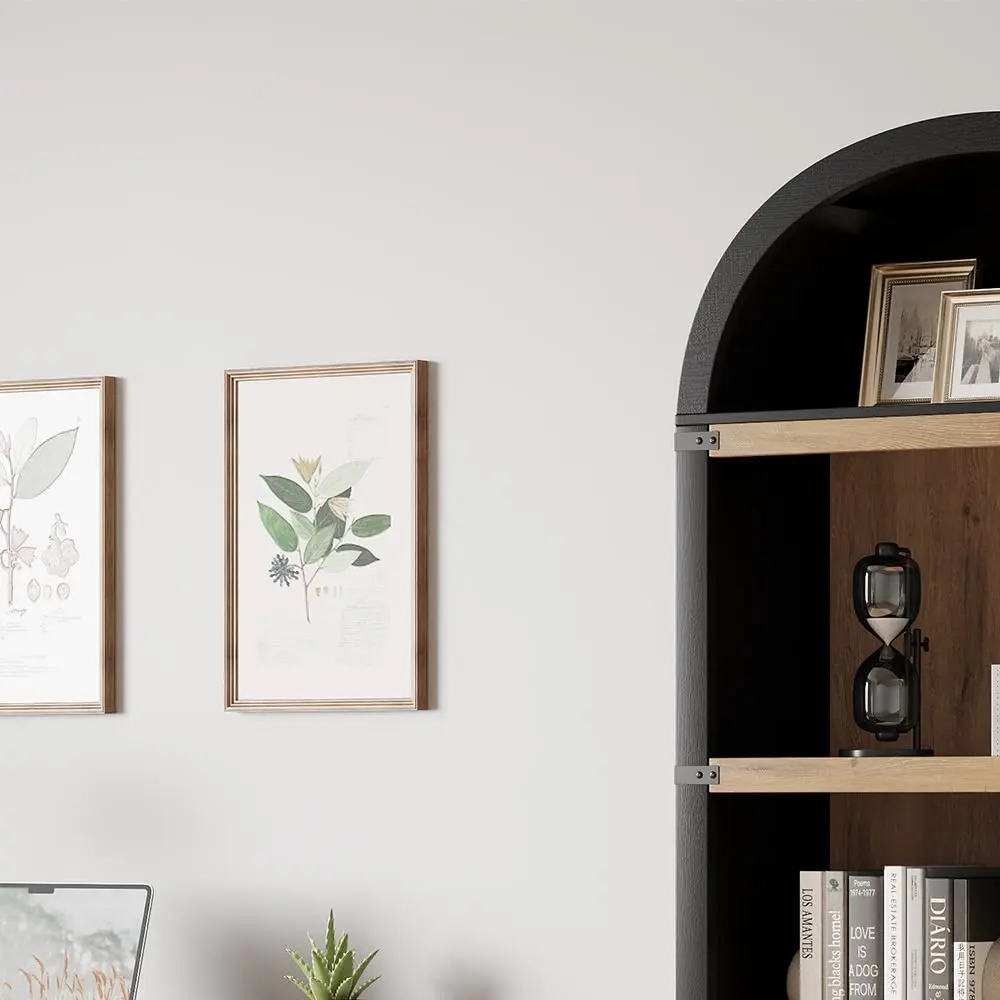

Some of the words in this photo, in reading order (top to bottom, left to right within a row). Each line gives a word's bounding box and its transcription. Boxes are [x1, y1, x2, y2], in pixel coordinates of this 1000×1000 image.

[801, 888, 814, 907] LOS
[890, 872, 898, 931] REAL-ESTATE
[801, 910, 814, 959] AMANTES
[828, 911, 841, 947] home!
[850, 926, 876, 940] LOVE
[929, 897, 951, 975] DIÁRIO
[828, 949, 841, 987] blacks
[857, 945, 867, 958] IS
[890, 935, 898, 994] BROKERAGE
[968, 944, 977, 975] ISBN
[848, 964, 856, 977] A
[855, 964, 879, 977] DOG
[849, 982, 877, 996] FROM
